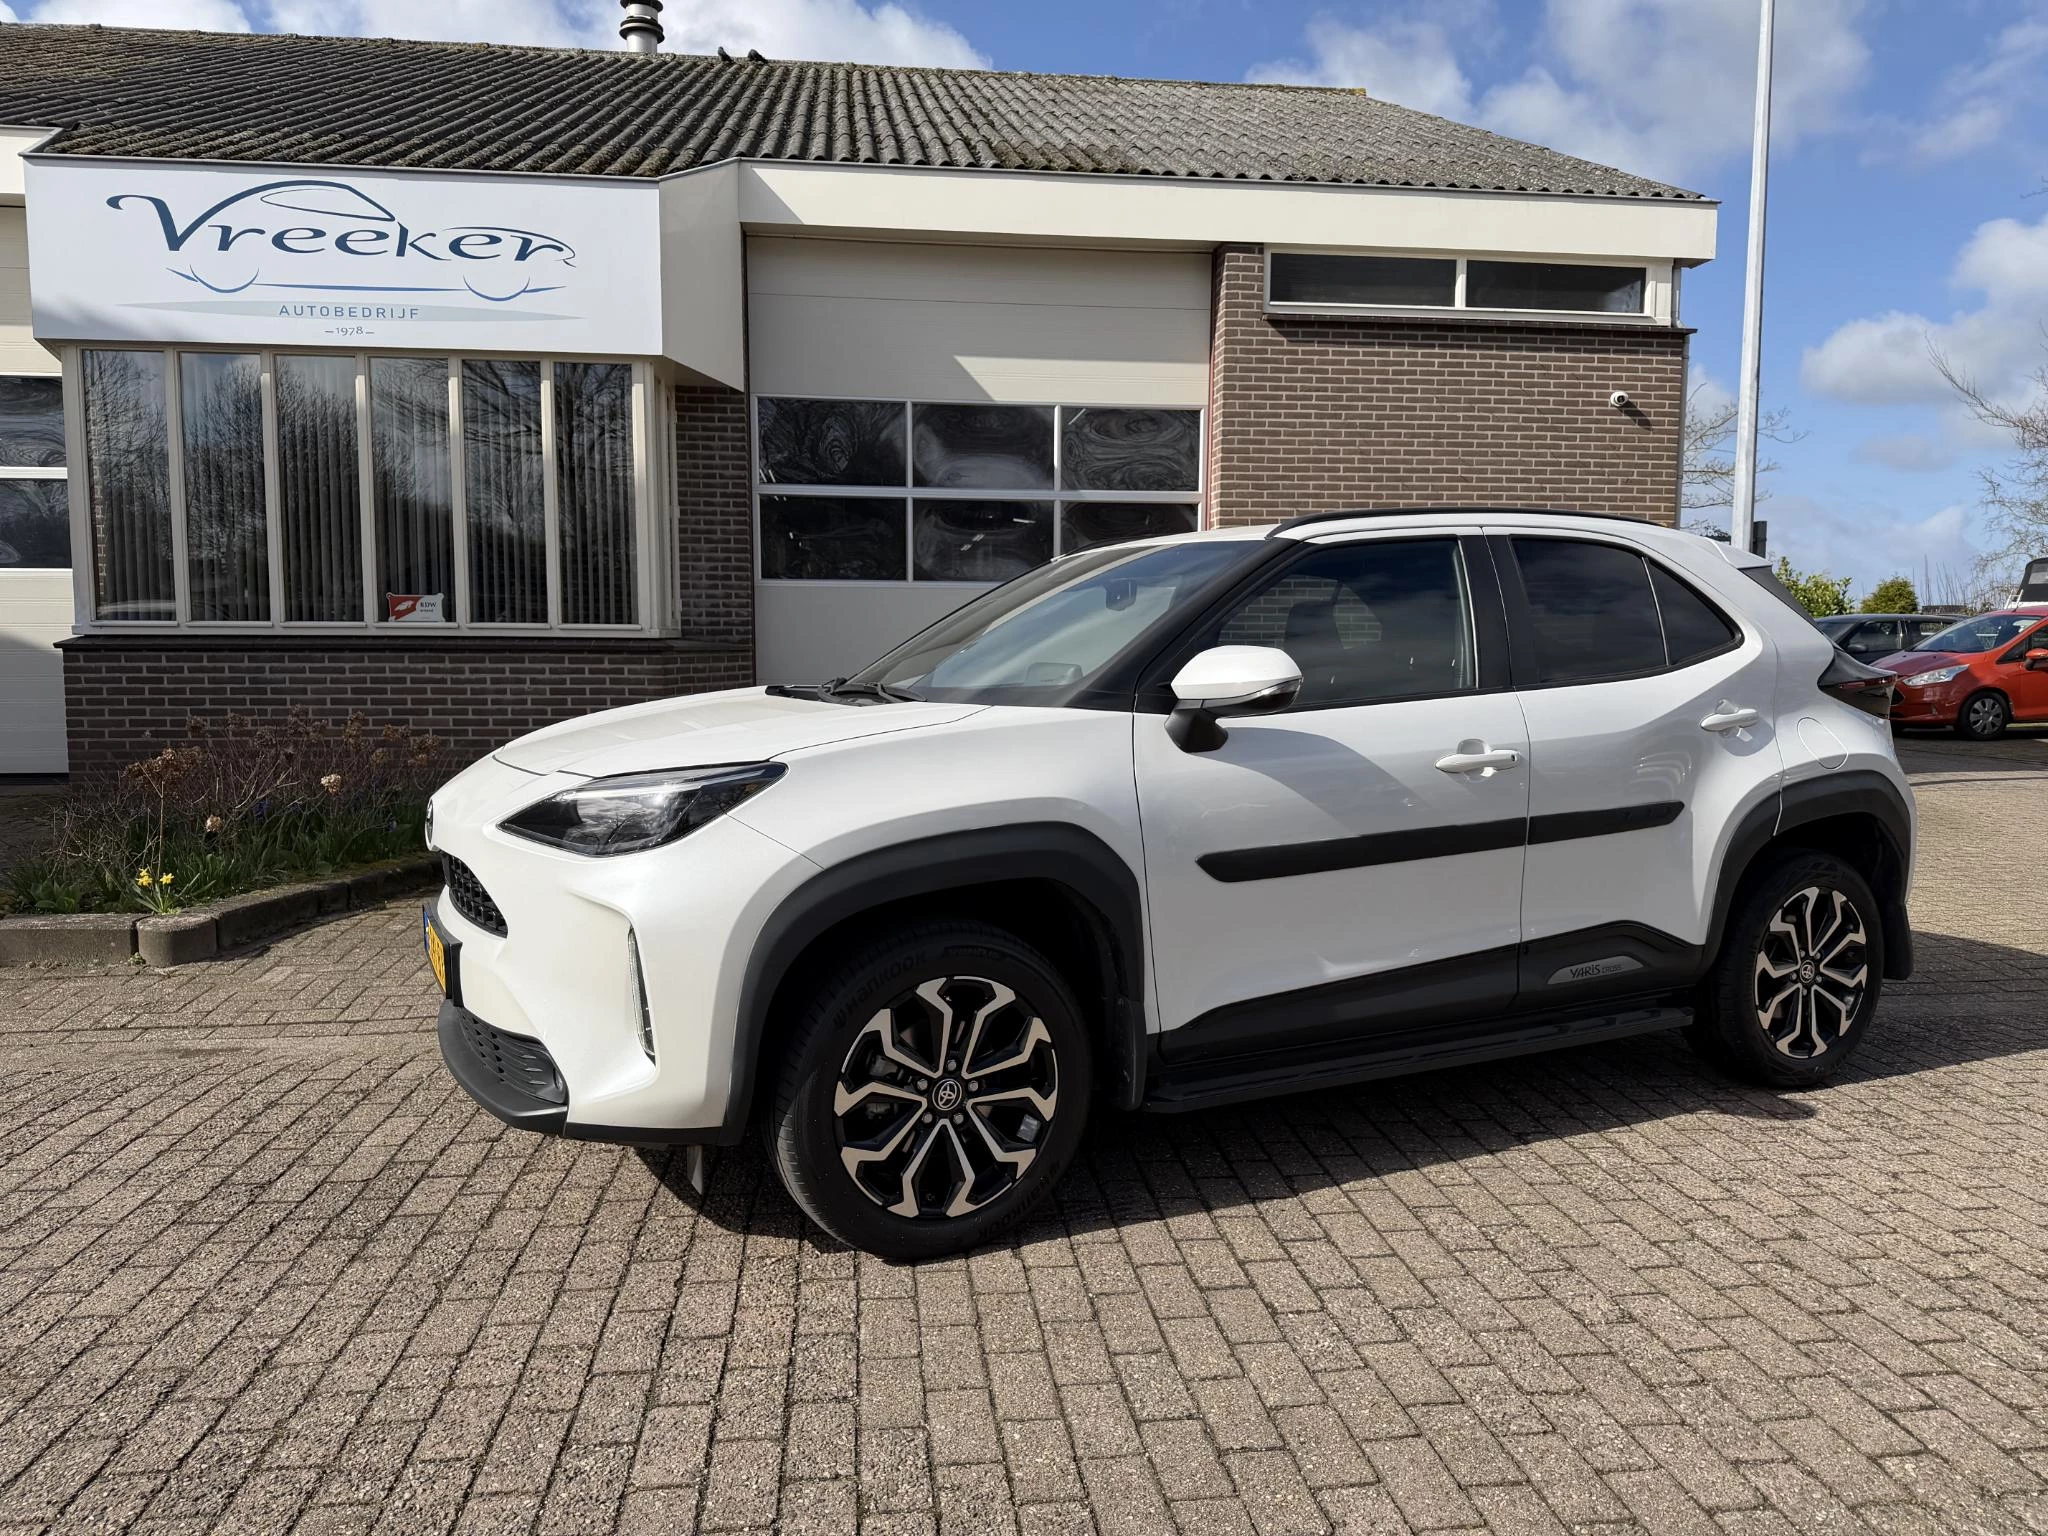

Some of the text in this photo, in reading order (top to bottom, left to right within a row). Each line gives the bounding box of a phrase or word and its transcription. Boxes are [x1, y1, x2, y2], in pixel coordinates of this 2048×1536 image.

[106, 179, 576, 268] Vreeker
[279, 304, 419, 319] AUTOBEDRIJF
[1570, 964, 1600, 979] YARIS
